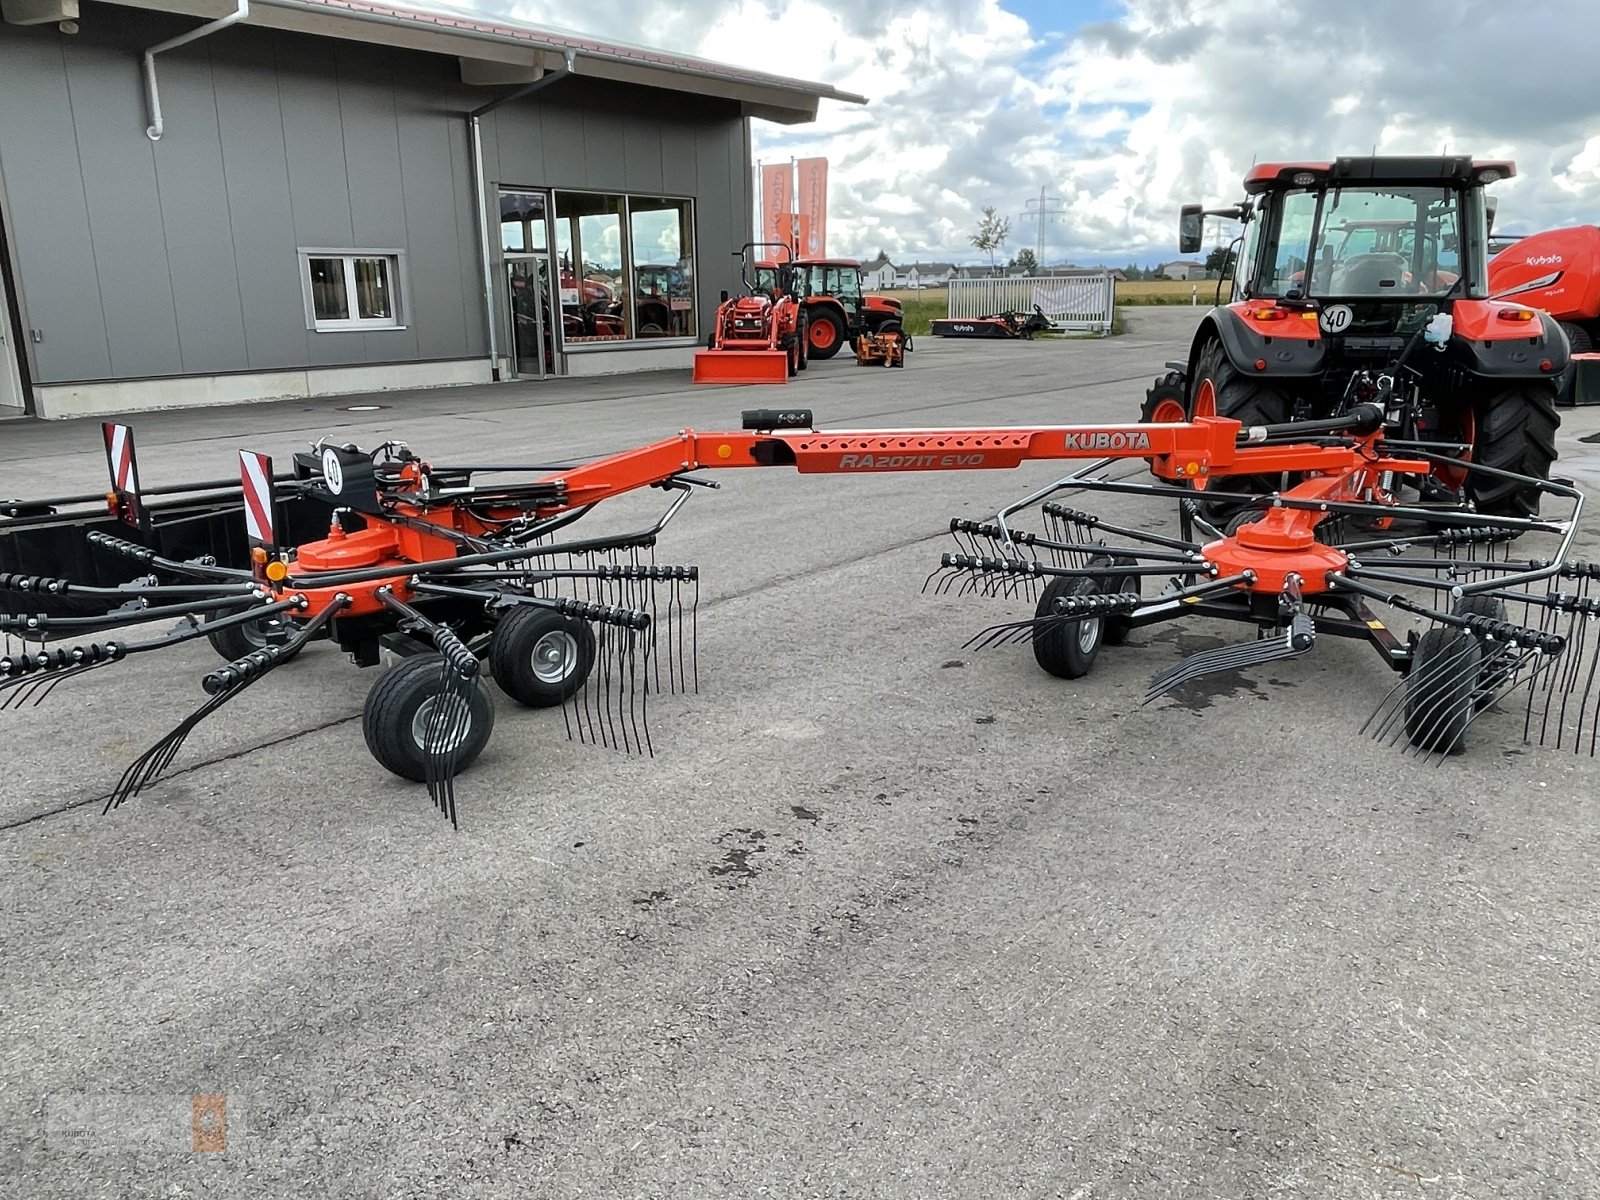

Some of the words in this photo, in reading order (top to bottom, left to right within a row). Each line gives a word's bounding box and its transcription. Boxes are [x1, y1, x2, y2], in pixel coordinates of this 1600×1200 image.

[1526, 255, 1562, 265] Kubota
[1326, 311, 1346, 327] 40
[1064, 432, 1151, 450] KUBOTA
[940, 453, 985, 466] EVO
[327, 457, 338, 486] 40
